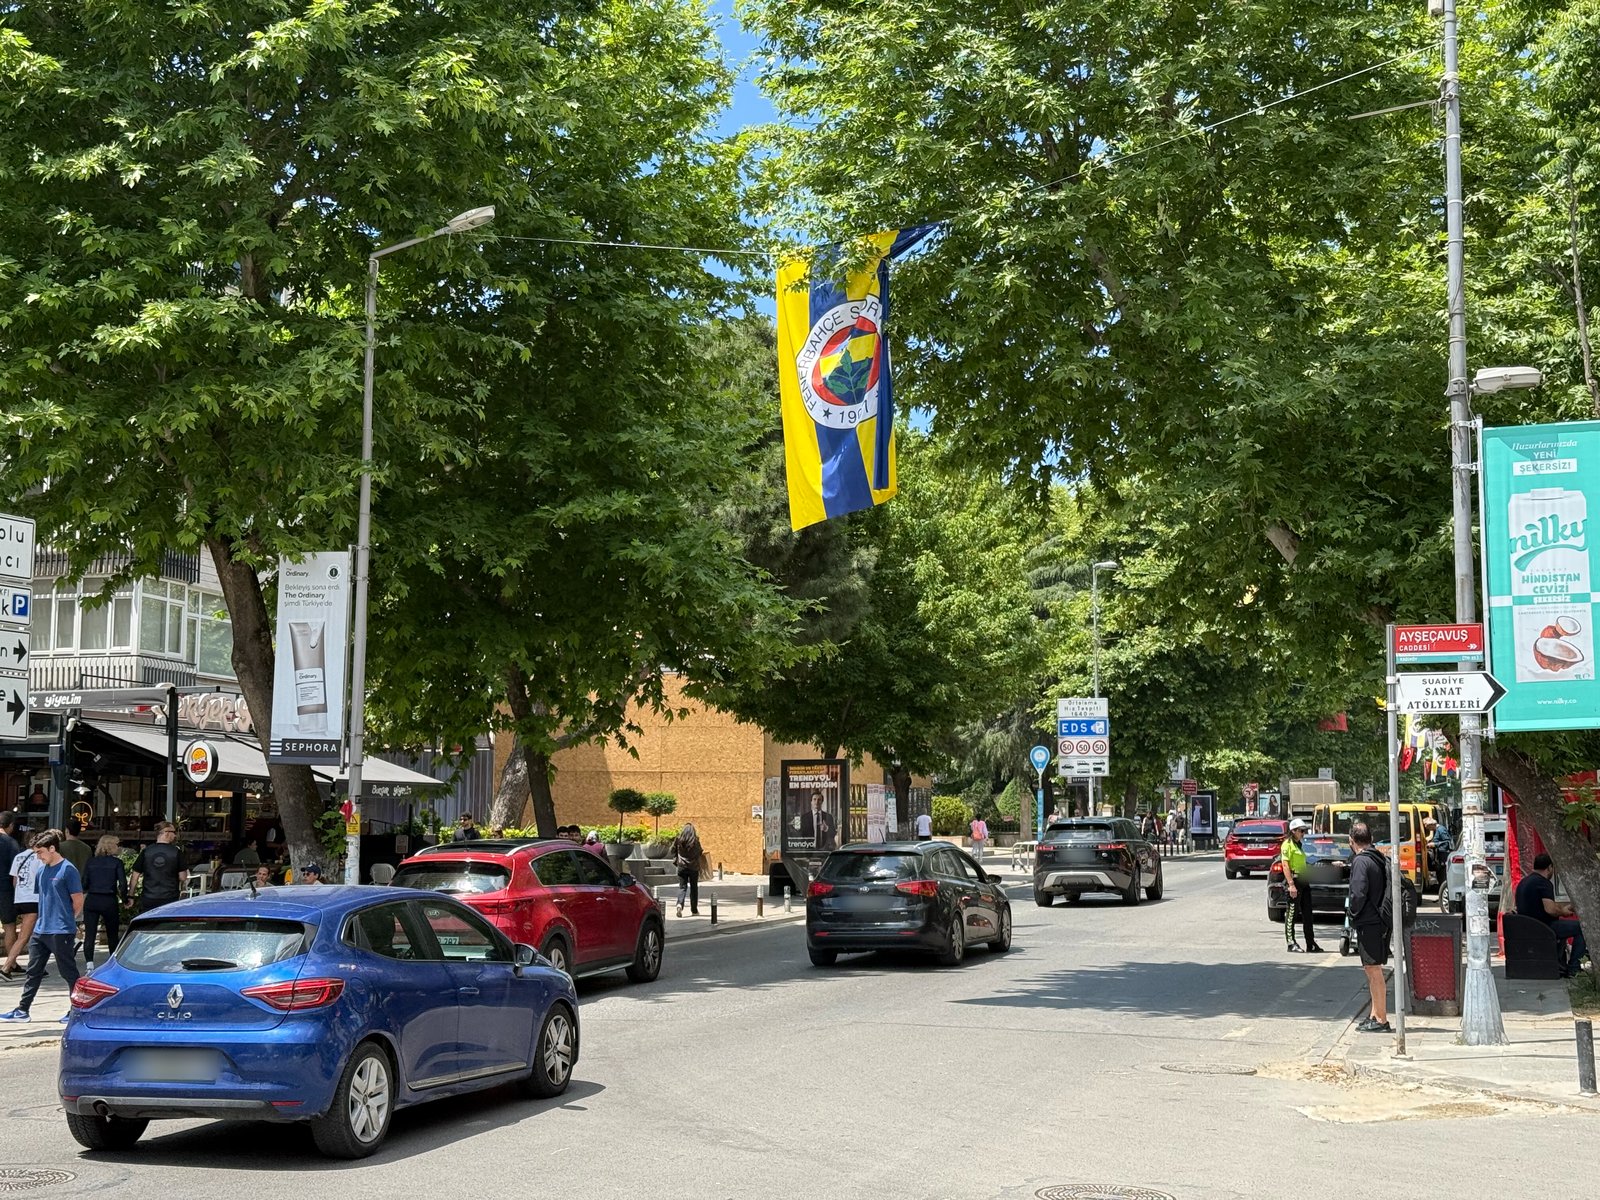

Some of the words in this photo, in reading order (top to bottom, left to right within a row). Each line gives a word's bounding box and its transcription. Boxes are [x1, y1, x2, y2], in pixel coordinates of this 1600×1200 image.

[797, 310, 844, 411] FENERBAHÇE
[1533, 449, 1557, 459] YENİ
[1519, 461, 1571, 475] ŞEKERSİZ!
[1521, 572, 1581, 584] HİNDİSTAN
[1533, 583, 1569, 593] CEVİZİ
[1399, 629, 1469, 643] AYŞEÇAVUŞ
[1399, 644, 1430, 652] CADDESİ
[1422, 676, 1464, 685] SUADİYE
[1425, 687, 1462, 696] SANAT
[1407, 698, 1480, 709] ATÖLYELERİ
[1061, 723, 1087, 733] EDS
[285, 742, 337, 752] SEPHORA
[1062, 743, 1071, 751] 50
[1079, 744, 1088, 752] 50
[1095, 744, 1104, 752] 50
[788, 840, 816, 848] trendyol
